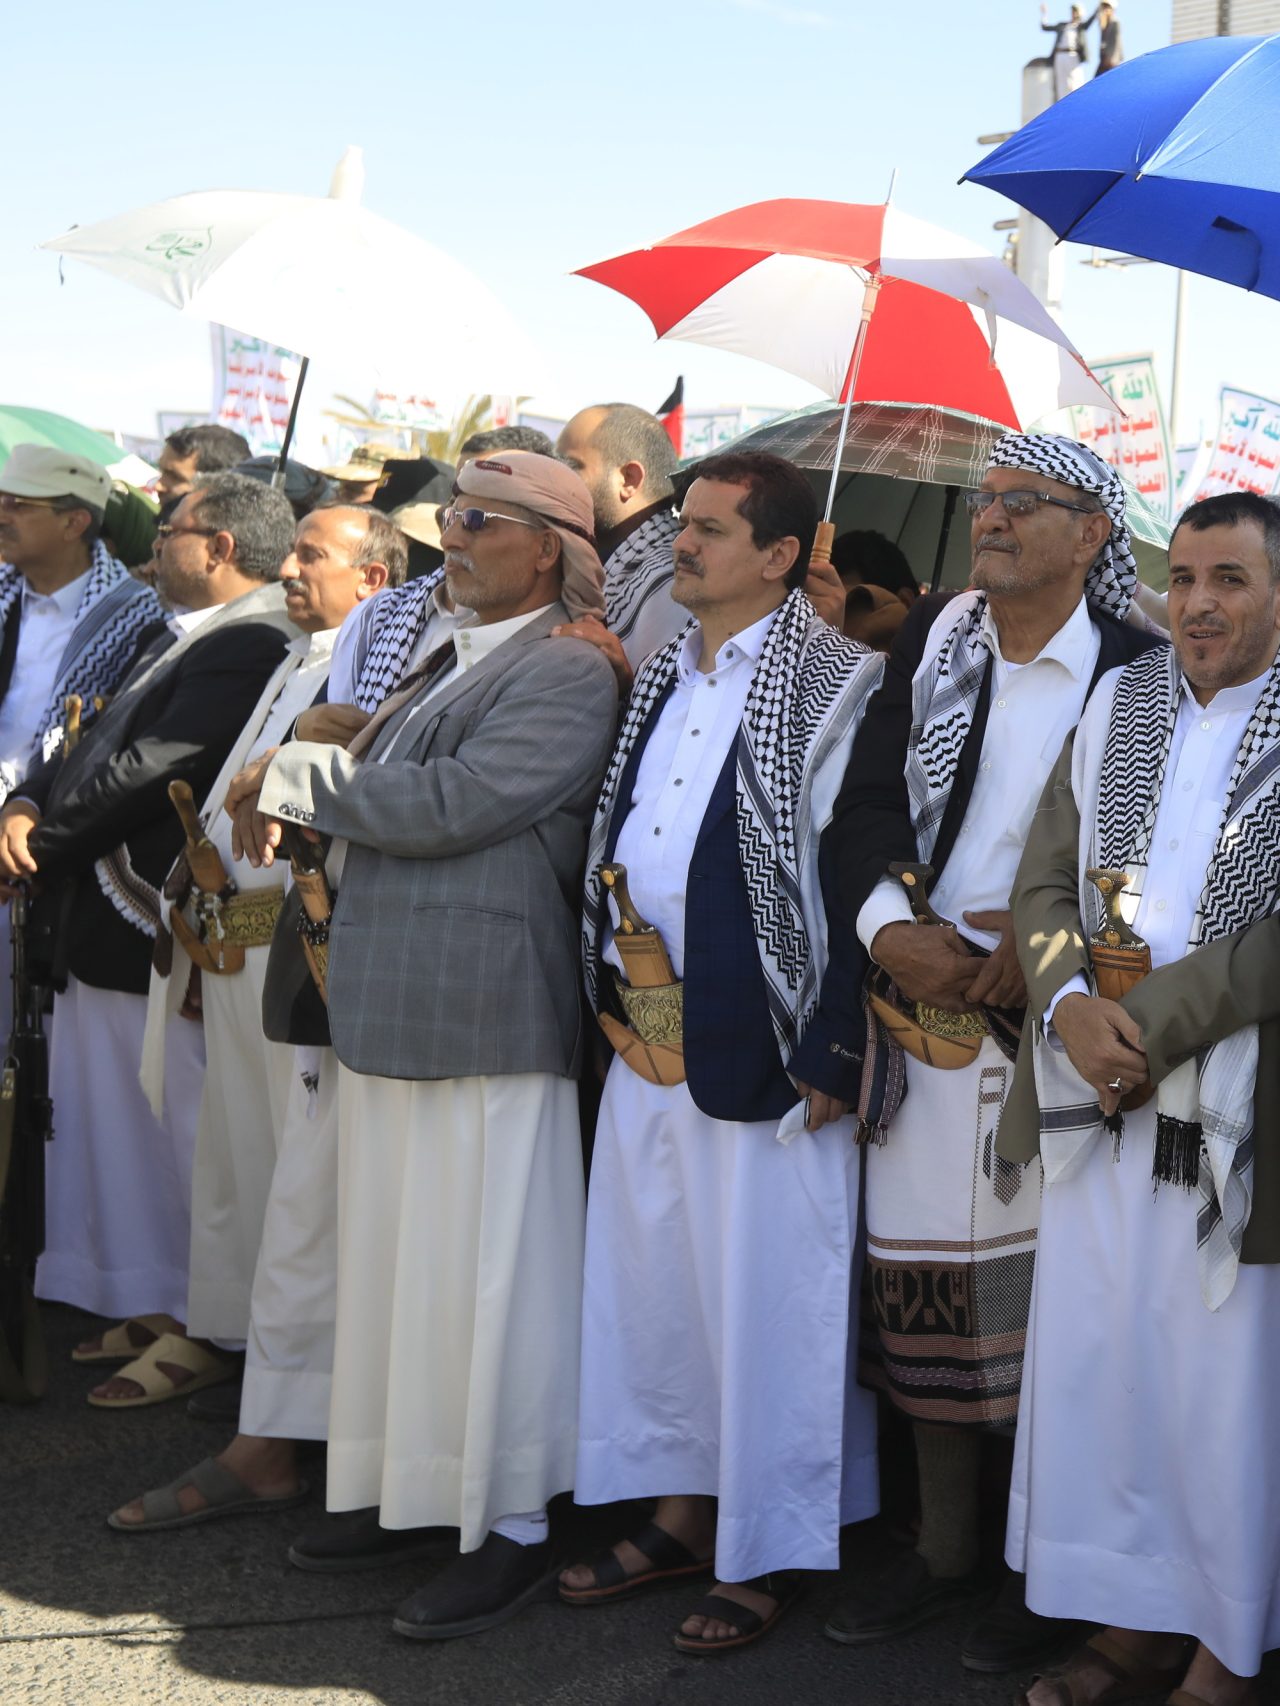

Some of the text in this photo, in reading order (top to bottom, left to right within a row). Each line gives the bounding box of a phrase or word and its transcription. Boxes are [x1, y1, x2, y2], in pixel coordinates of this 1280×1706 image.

[1121, 372, 1152, 399] الله
[1120, 410, 1158, 436] الموت
[1224, 402, 1265, 432] أكبر
[1123, 441, 1163, 468] الموت
[1248, 448, 1280, 470] الموت
